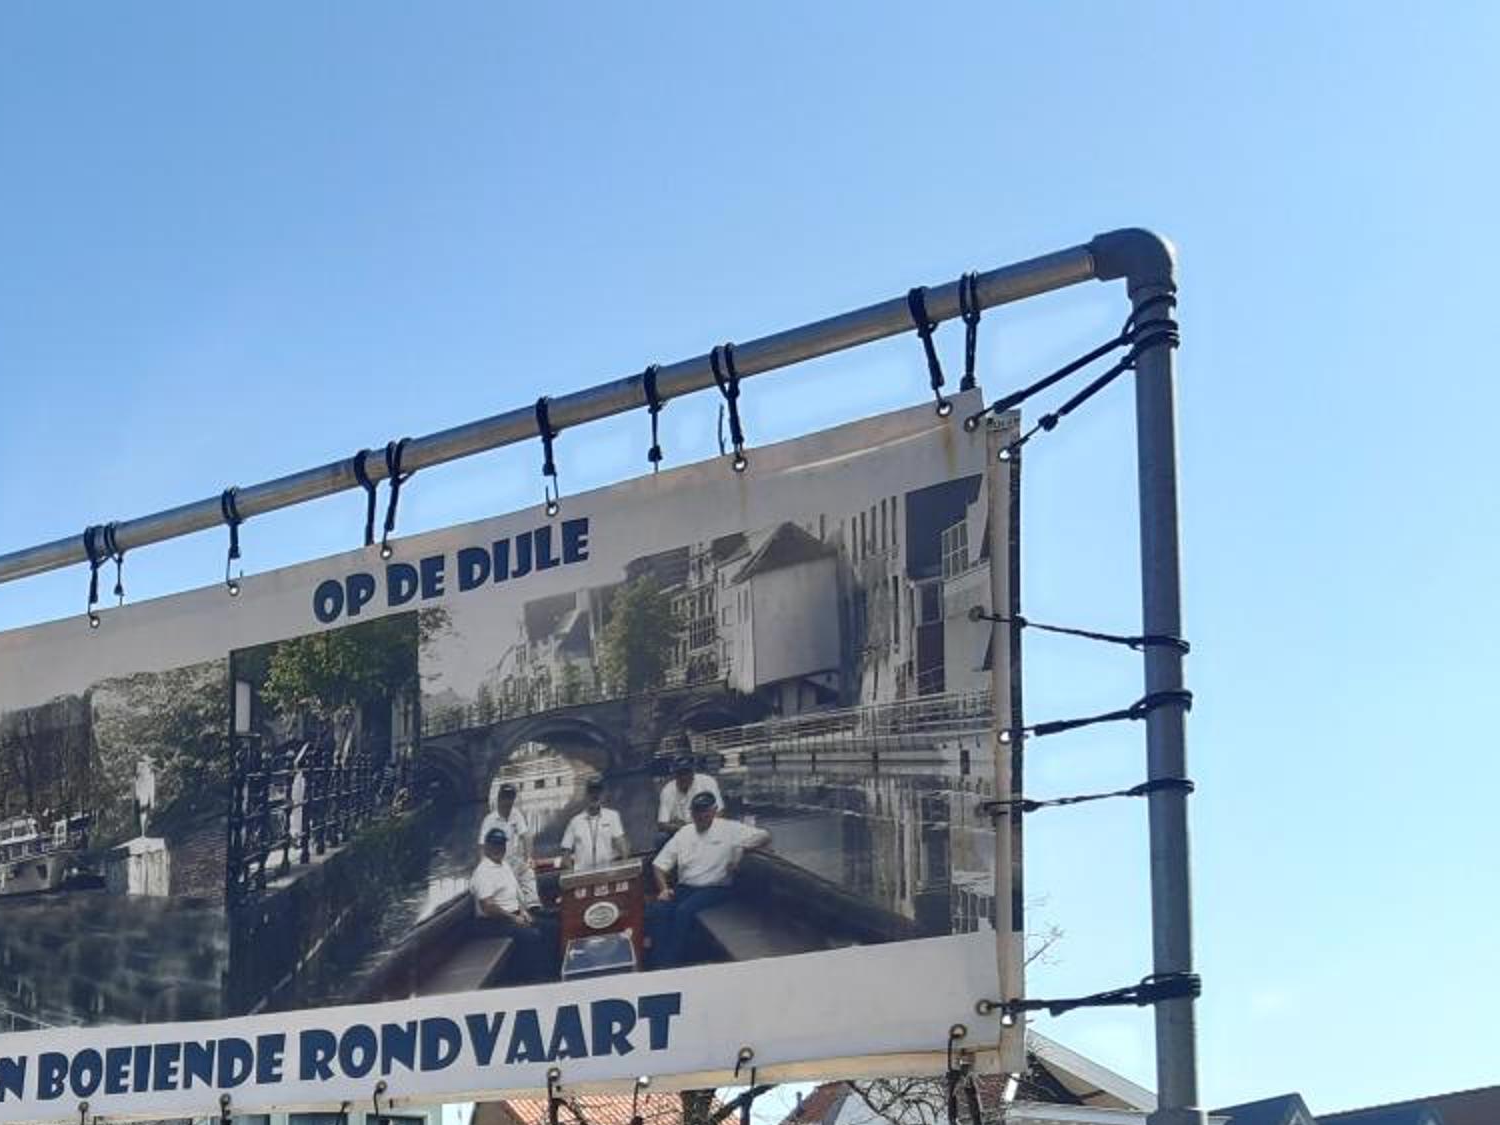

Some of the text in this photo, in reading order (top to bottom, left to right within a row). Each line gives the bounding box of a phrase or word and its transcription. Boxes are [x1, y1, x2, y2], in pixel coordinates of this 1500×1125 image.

[313, 517, 589, 624] OP DE DIJLE
[37, 1033, 287, 1101] BOEIENDE
[298, 992, 682, 1081] RONDVAART
